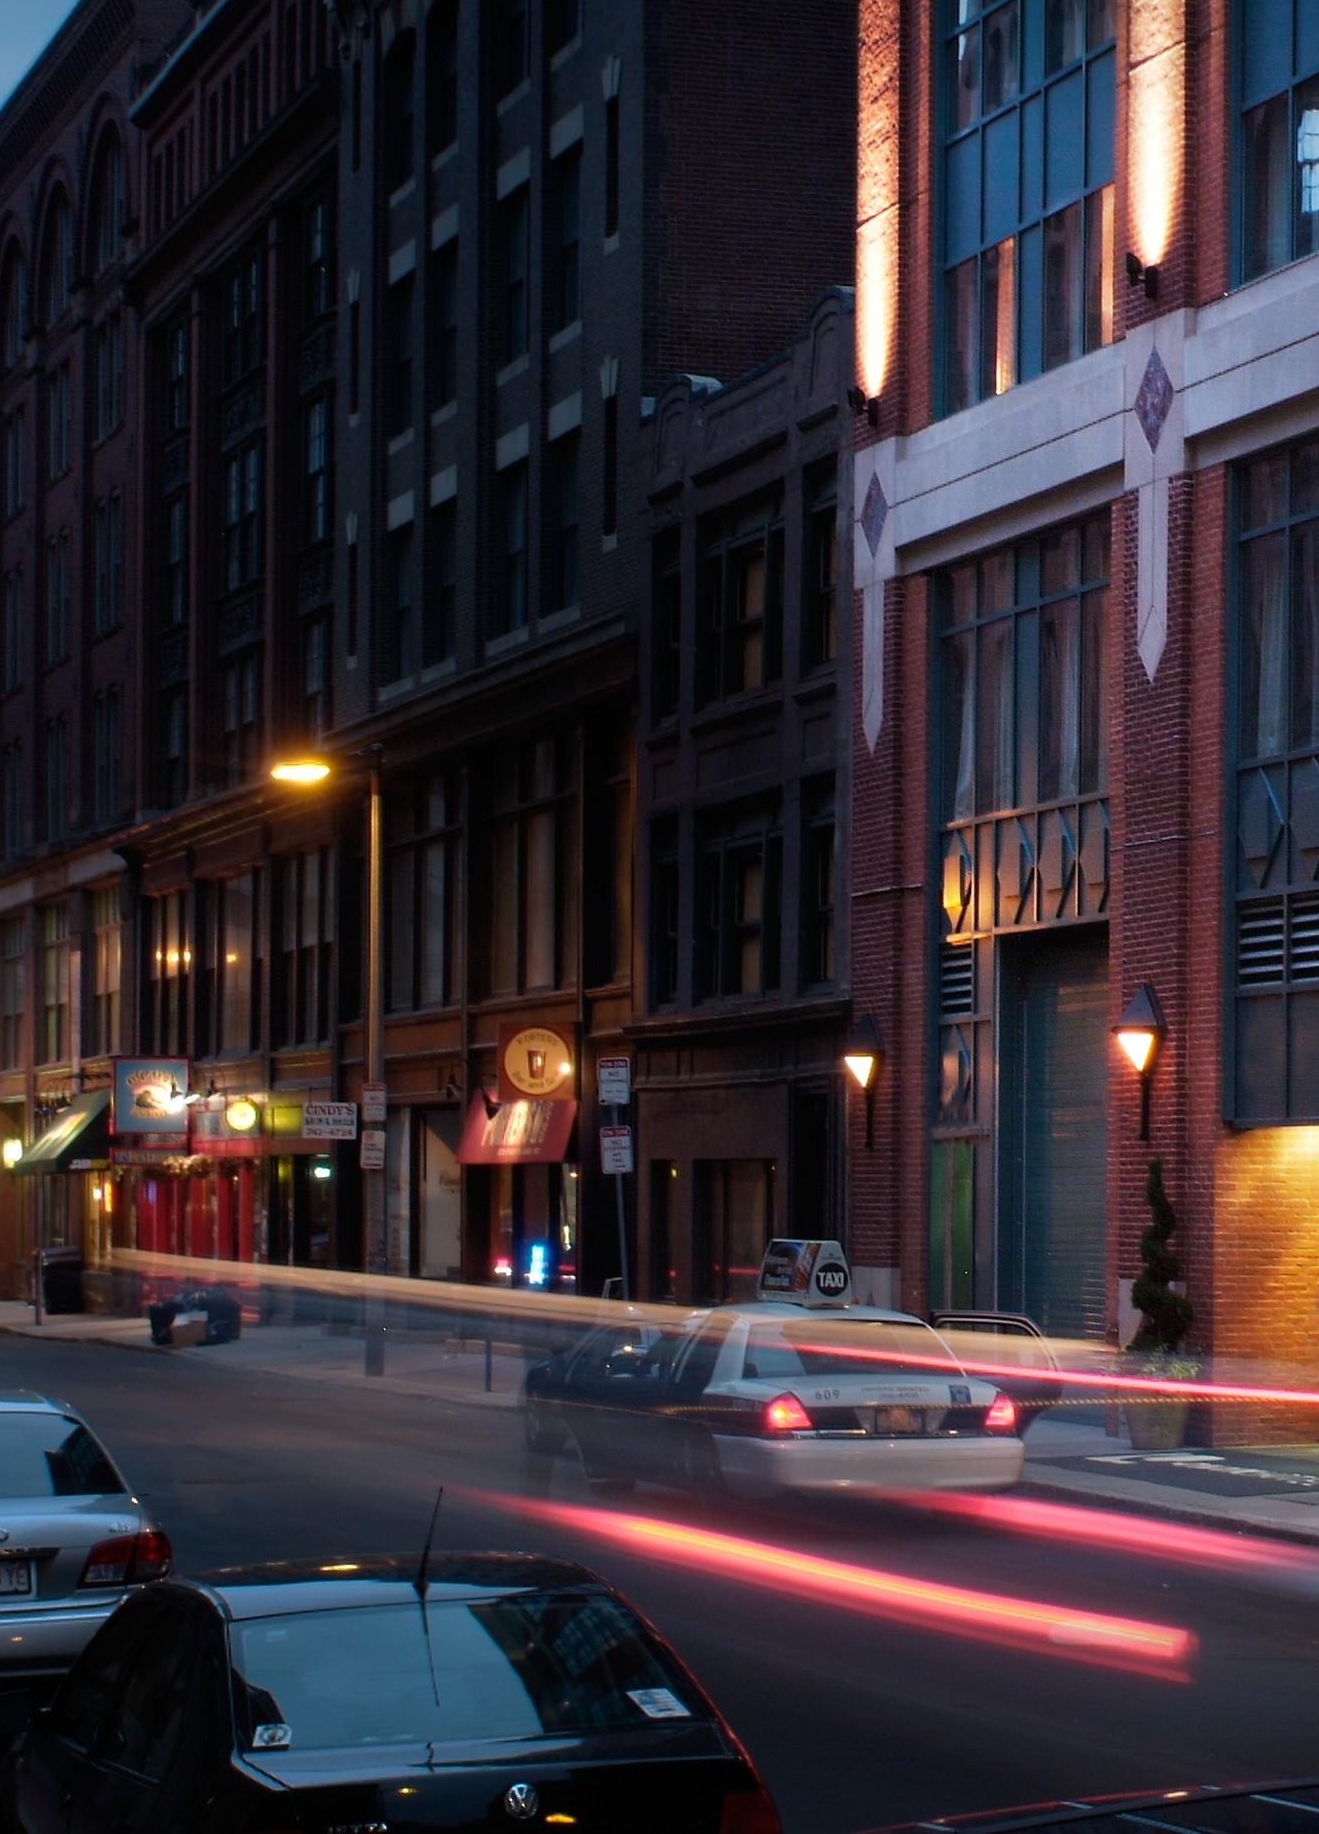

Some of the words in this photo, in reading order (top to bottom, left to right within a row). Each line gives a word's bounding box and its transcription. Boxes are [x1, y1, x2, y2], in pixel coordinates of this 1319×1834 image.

[305, 1105, 355, 1116] CINDY'S
[818, 1271, 845, 1288] TAXI
[814, 1389, 840, 1400] 609
